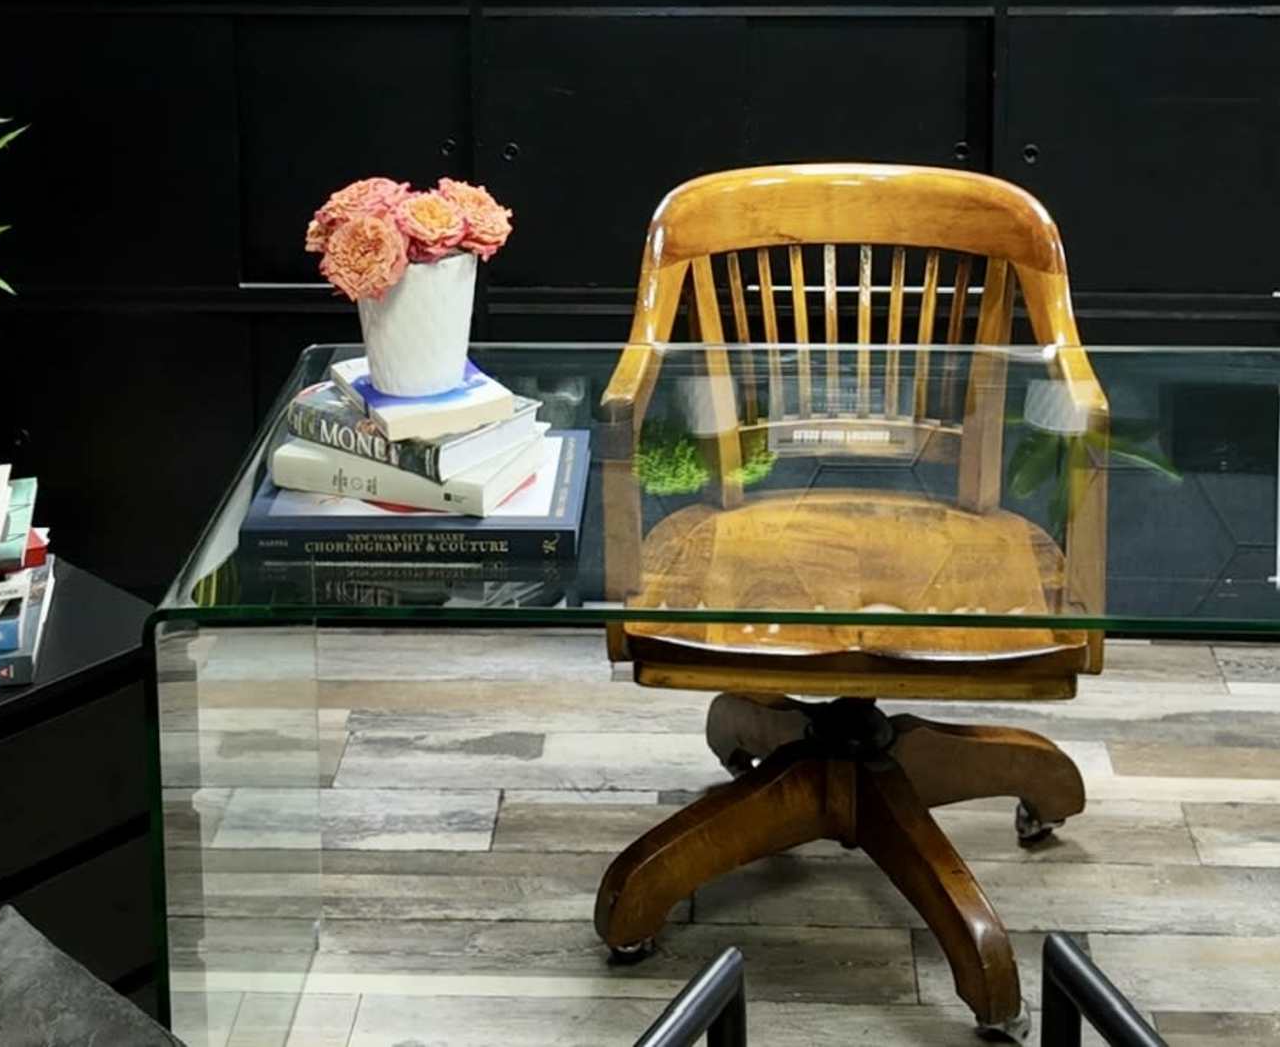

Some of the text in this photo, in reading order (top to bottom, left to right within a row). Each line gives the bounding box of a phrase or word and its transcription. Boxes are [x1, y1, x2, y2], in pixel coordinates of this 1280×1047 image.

[305, 540, 509, 554] CHOREOGRAPHY & COUTURE
